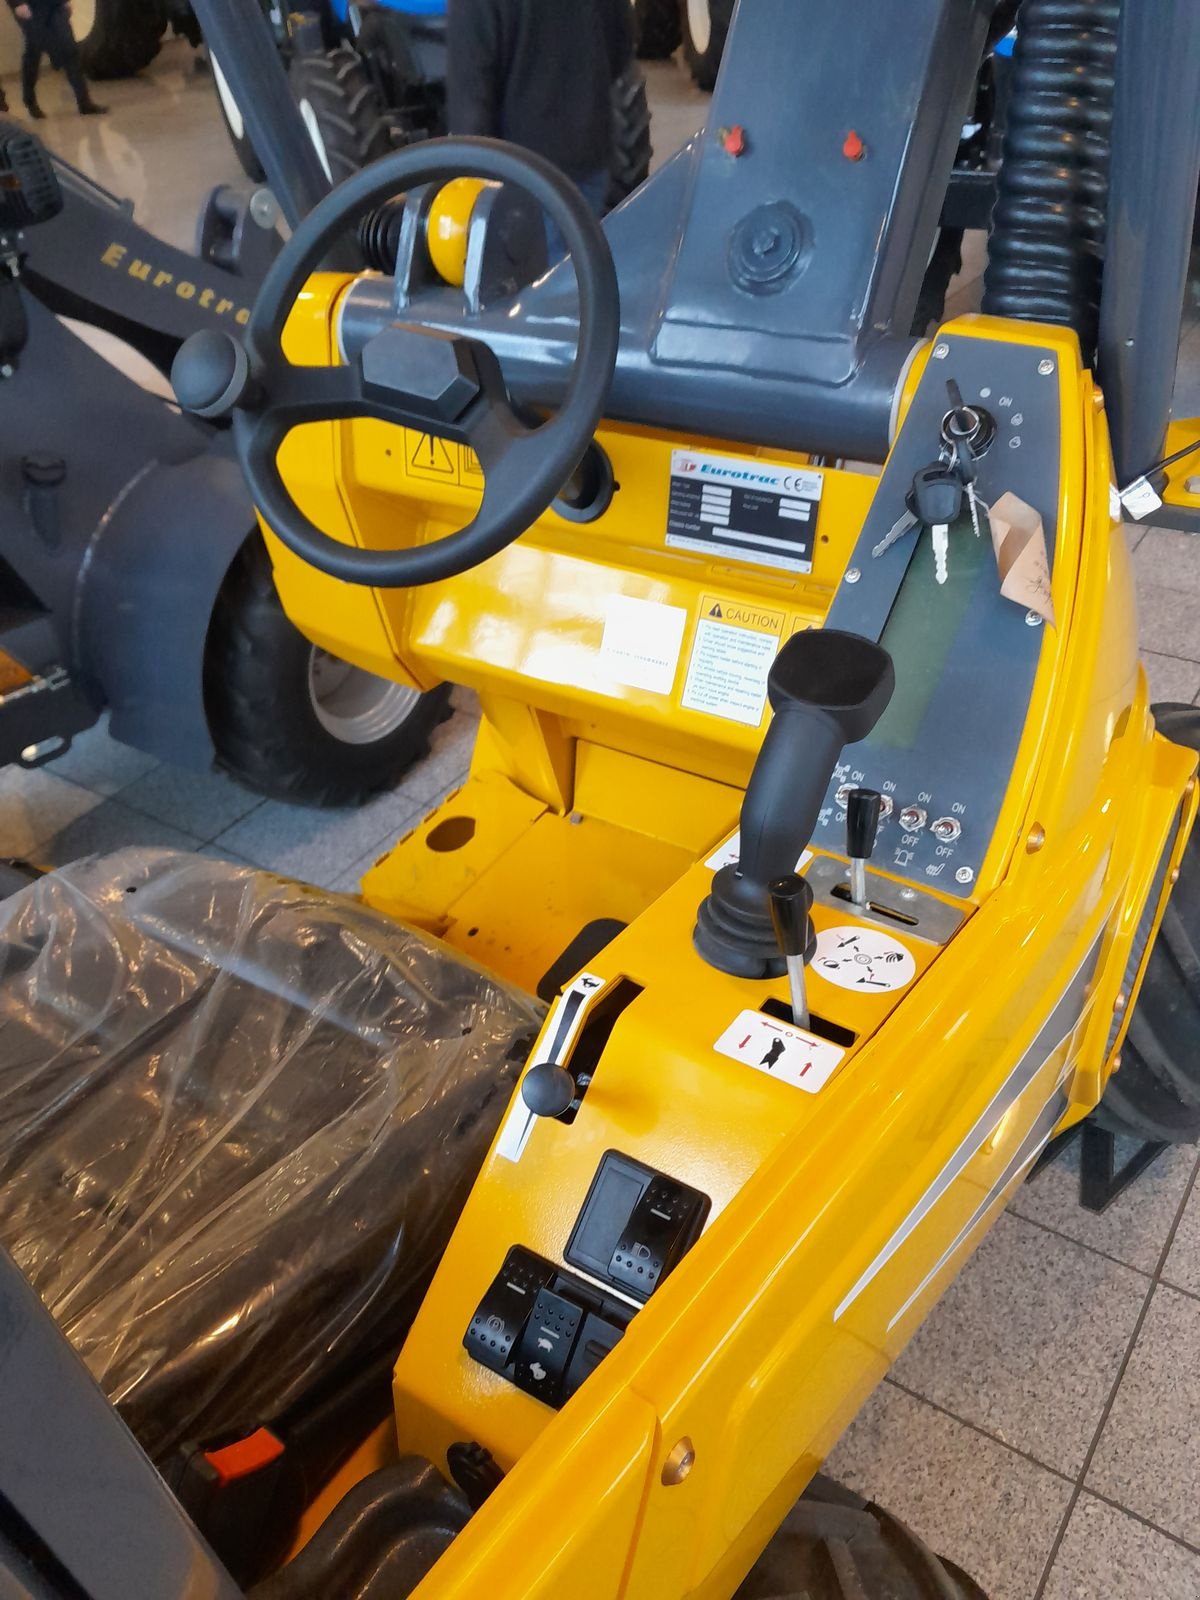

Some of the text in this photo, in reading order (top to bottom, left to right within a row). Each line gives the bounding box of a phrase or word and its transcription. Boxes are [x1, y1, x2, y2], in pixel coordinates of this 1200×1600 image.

[100, 242, 251, 325] Eurotra
[998, 396, 1013, 407] ON
[700, 463, 781, 486] Eurotrac
[725, 607, 779, 629] CAUTION
[851, 770, 865, 782] ON
[882, 780, 897, 792] ON
[917, 791, 932, 804] ON
[951, 802, 966, 815] ON
[901, 834, 920, 847] OFF
[935, 845, 954, 858] OFF
